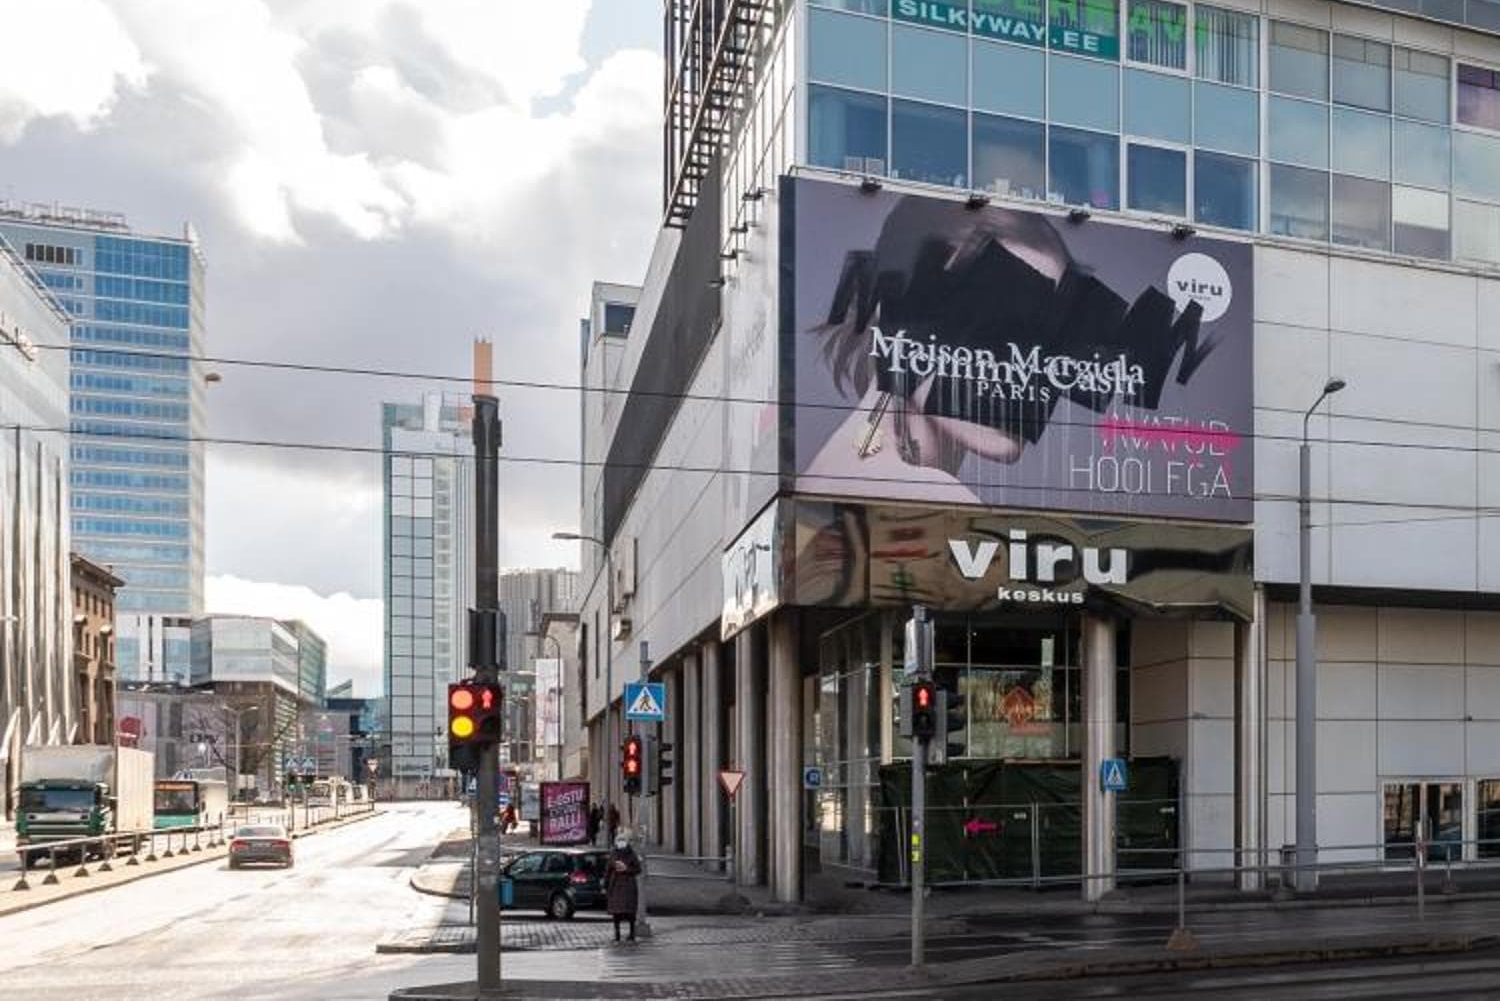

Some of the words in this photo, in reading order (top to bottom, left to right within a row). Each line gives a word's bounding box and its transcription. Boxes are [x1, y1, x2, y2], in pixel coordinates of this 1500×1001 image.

[1176, 278, 1222, 296] viru
[976, 379, 1052, 403] PARIS
[948, 528, 1128, 585] viru
[997, 587, 1084, 604] keskus
